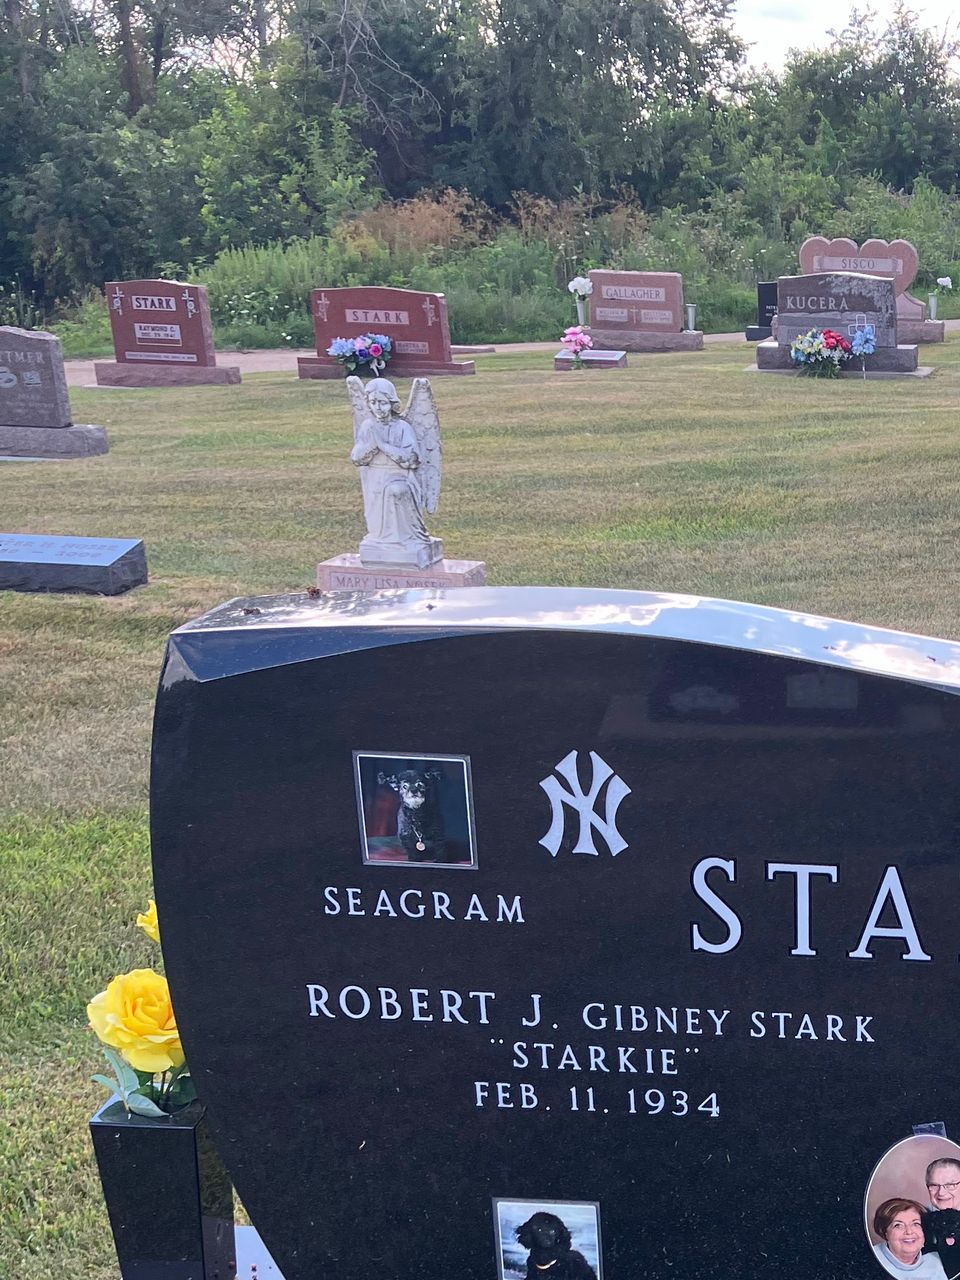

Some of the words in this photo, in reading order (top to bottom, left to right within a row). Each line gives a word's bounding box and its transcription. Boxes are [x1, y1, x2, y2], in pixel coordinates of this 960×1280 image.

[841, 258, 876, 270] SISCO
[605, 287, 661, 299] GALLAGHER
[135, 297, 173, 310] STARK
[786, 296, 849, 311] KUCERA
[352, 310, 403, 323] STARK
[335, 576, 369, 589] MARY
[374, 578, 399, 589] LISA
[538, 749, 632, 857] NY
[324, 886, 525, 923] SEAGRAM
[306, 984, 496, 1024] ROBERT
[522, 994, 558, 1029] J.
[582, 1002, 731, 1036] GIBNEY
[750, 1011, 875, 1043] STARK
[474, 1081, 551, 1111] FEB.
[569, 1086, 609, 1114] 11.
[627, 1088, 720, 1117] 1934
